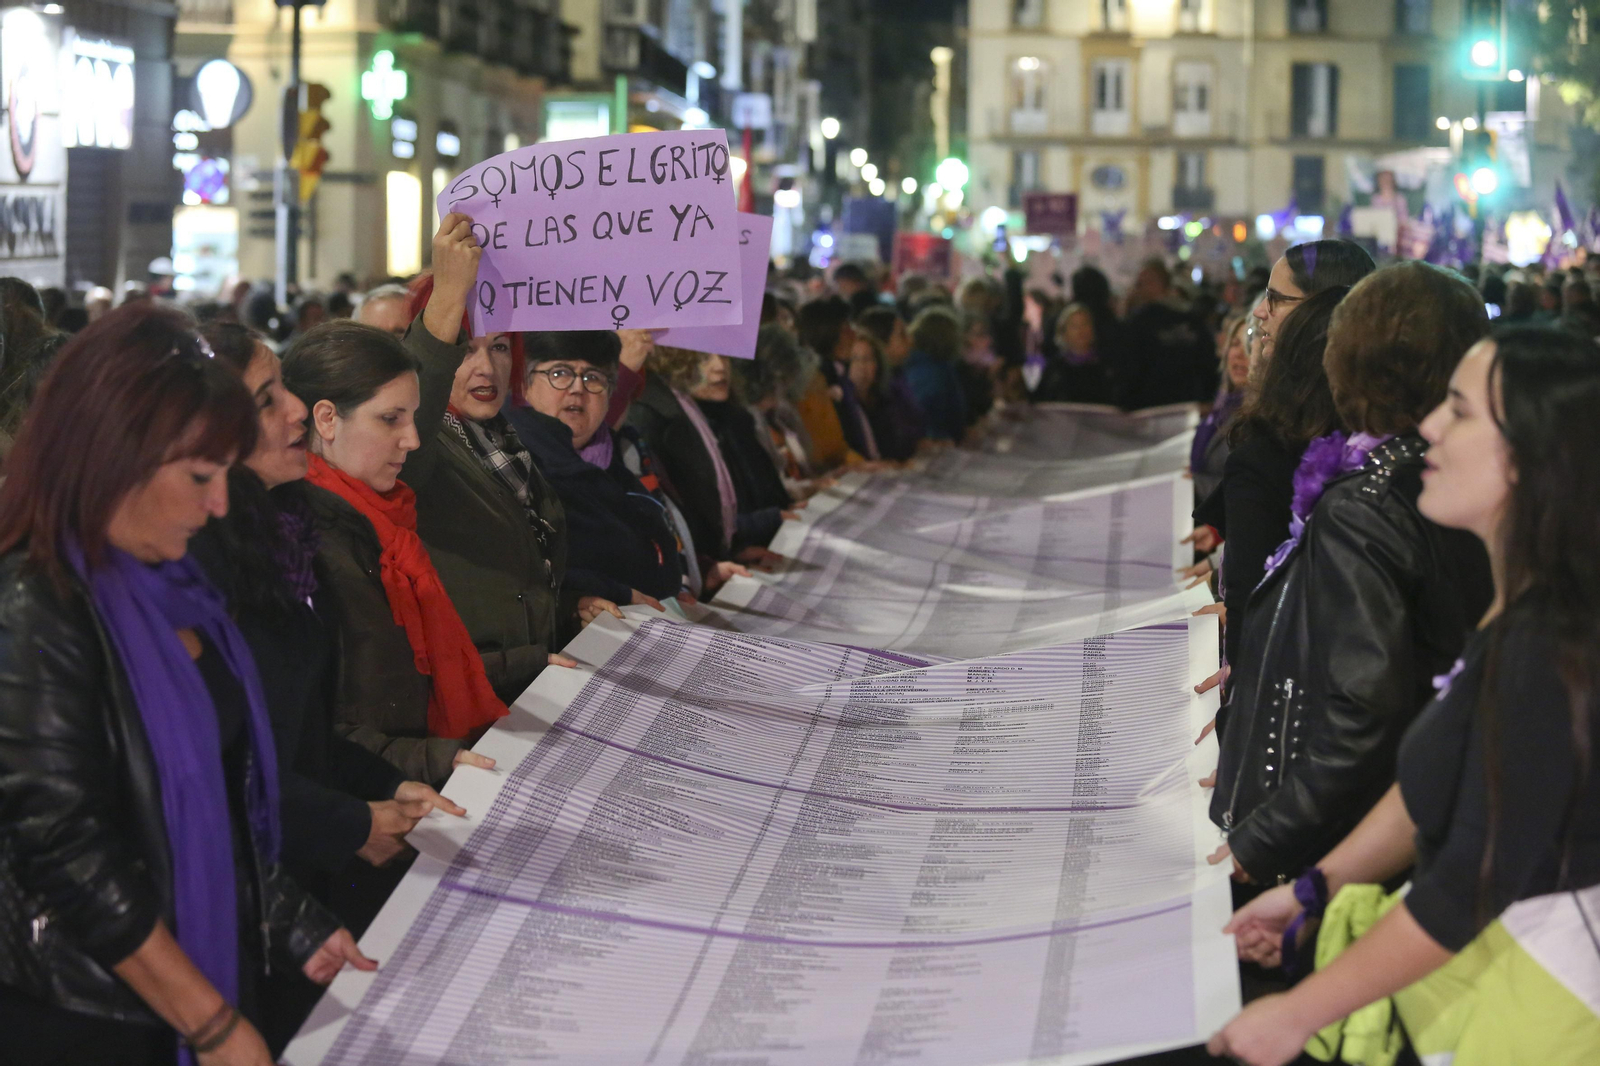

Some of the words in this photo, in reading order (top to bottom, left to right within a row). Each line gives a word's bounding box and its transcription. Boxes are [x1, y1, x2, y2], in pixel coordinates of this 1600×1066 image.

[449, 150, 585, 208] SOMOS
[472, 221, 508, 250] DE
[526, 214, 577, 247] LAS
[592, 208, 653, 240] QUE
[670, 204, 714, 242] YA
[475, 280, 496, 316] O
[646, 270, 732, 311] VOZ
